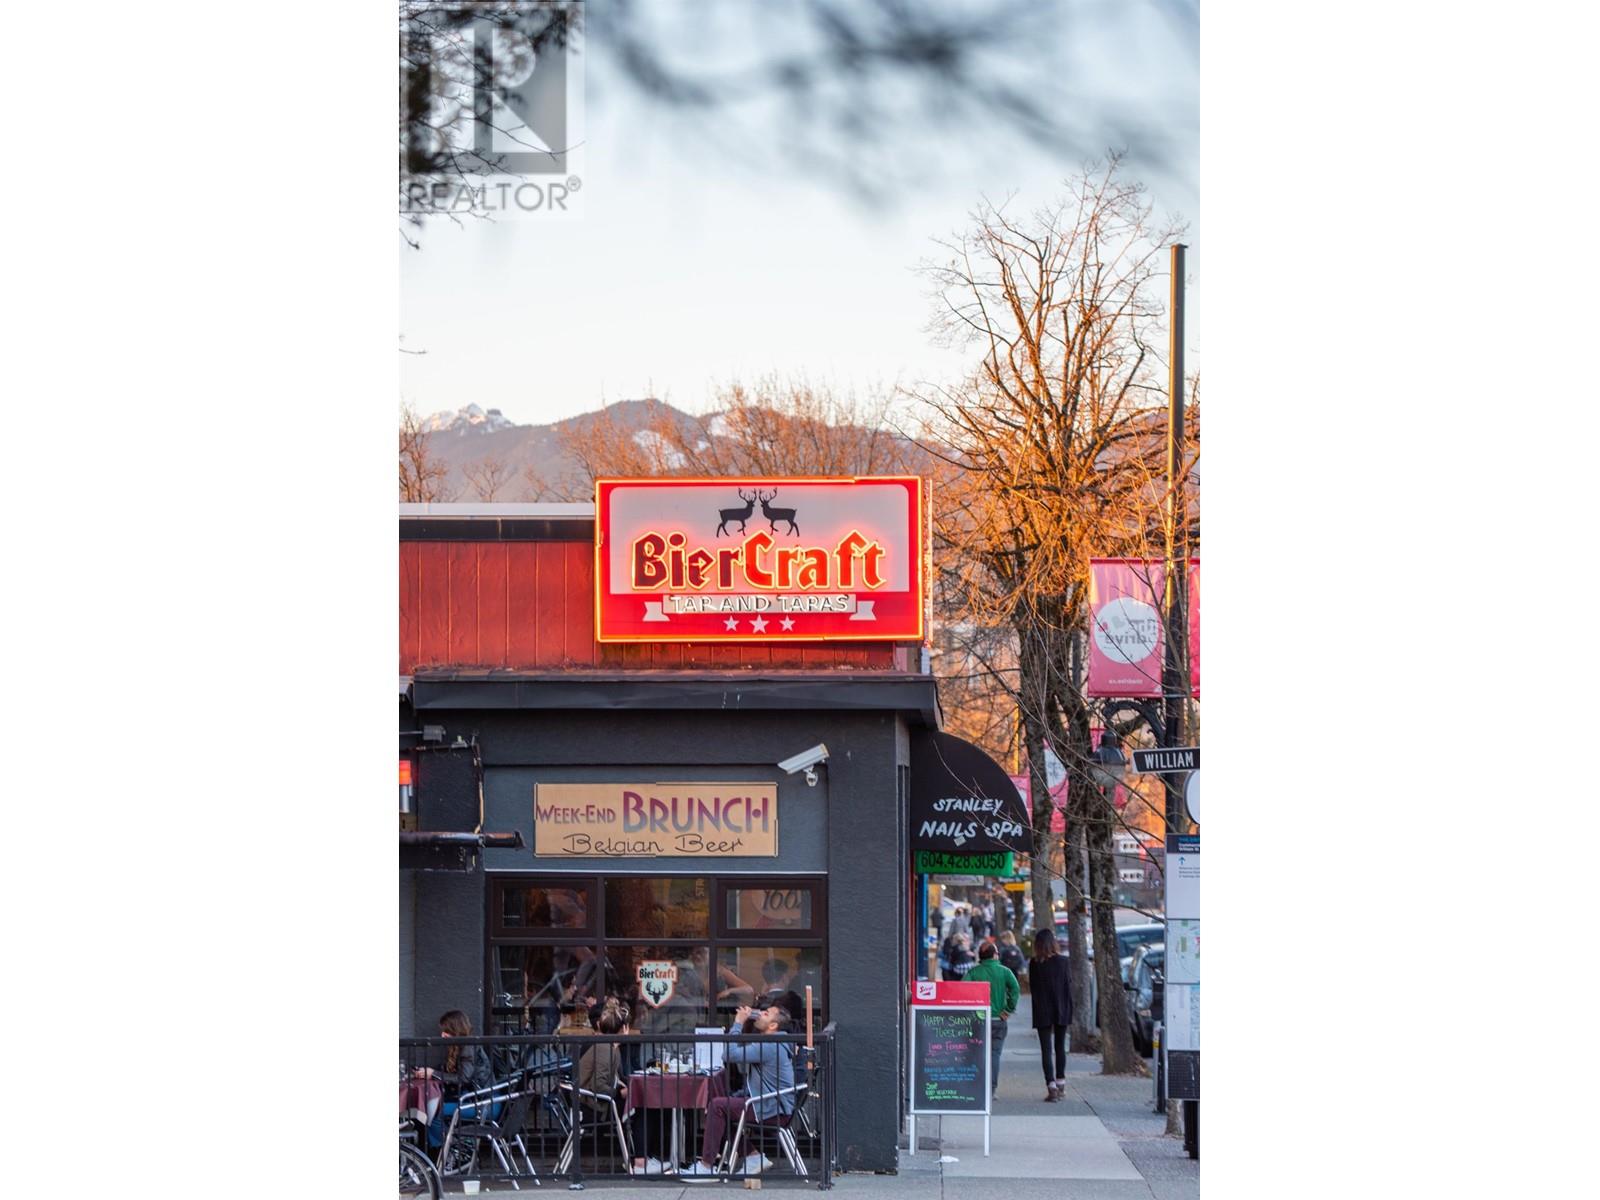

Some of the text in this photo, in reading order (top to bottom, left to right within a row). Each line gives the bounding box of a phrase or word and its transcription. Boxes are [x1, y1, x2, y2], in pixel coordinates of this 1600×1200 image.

[631, 529, 887, 590] BierCraft
[669, 594, 849, 612] TAP AND TAPAS
[1144, 752, 1194, 769] WILLIAM
[623, 791, 769, 833] BRUNCH
[933, 798, 1003, 816] STANLEY
[920, 820, 1023, 839] NAILS SPA
[563, 833, 744, 856] Belgian Beer
[639, 967, 675, 979] BierCraft
